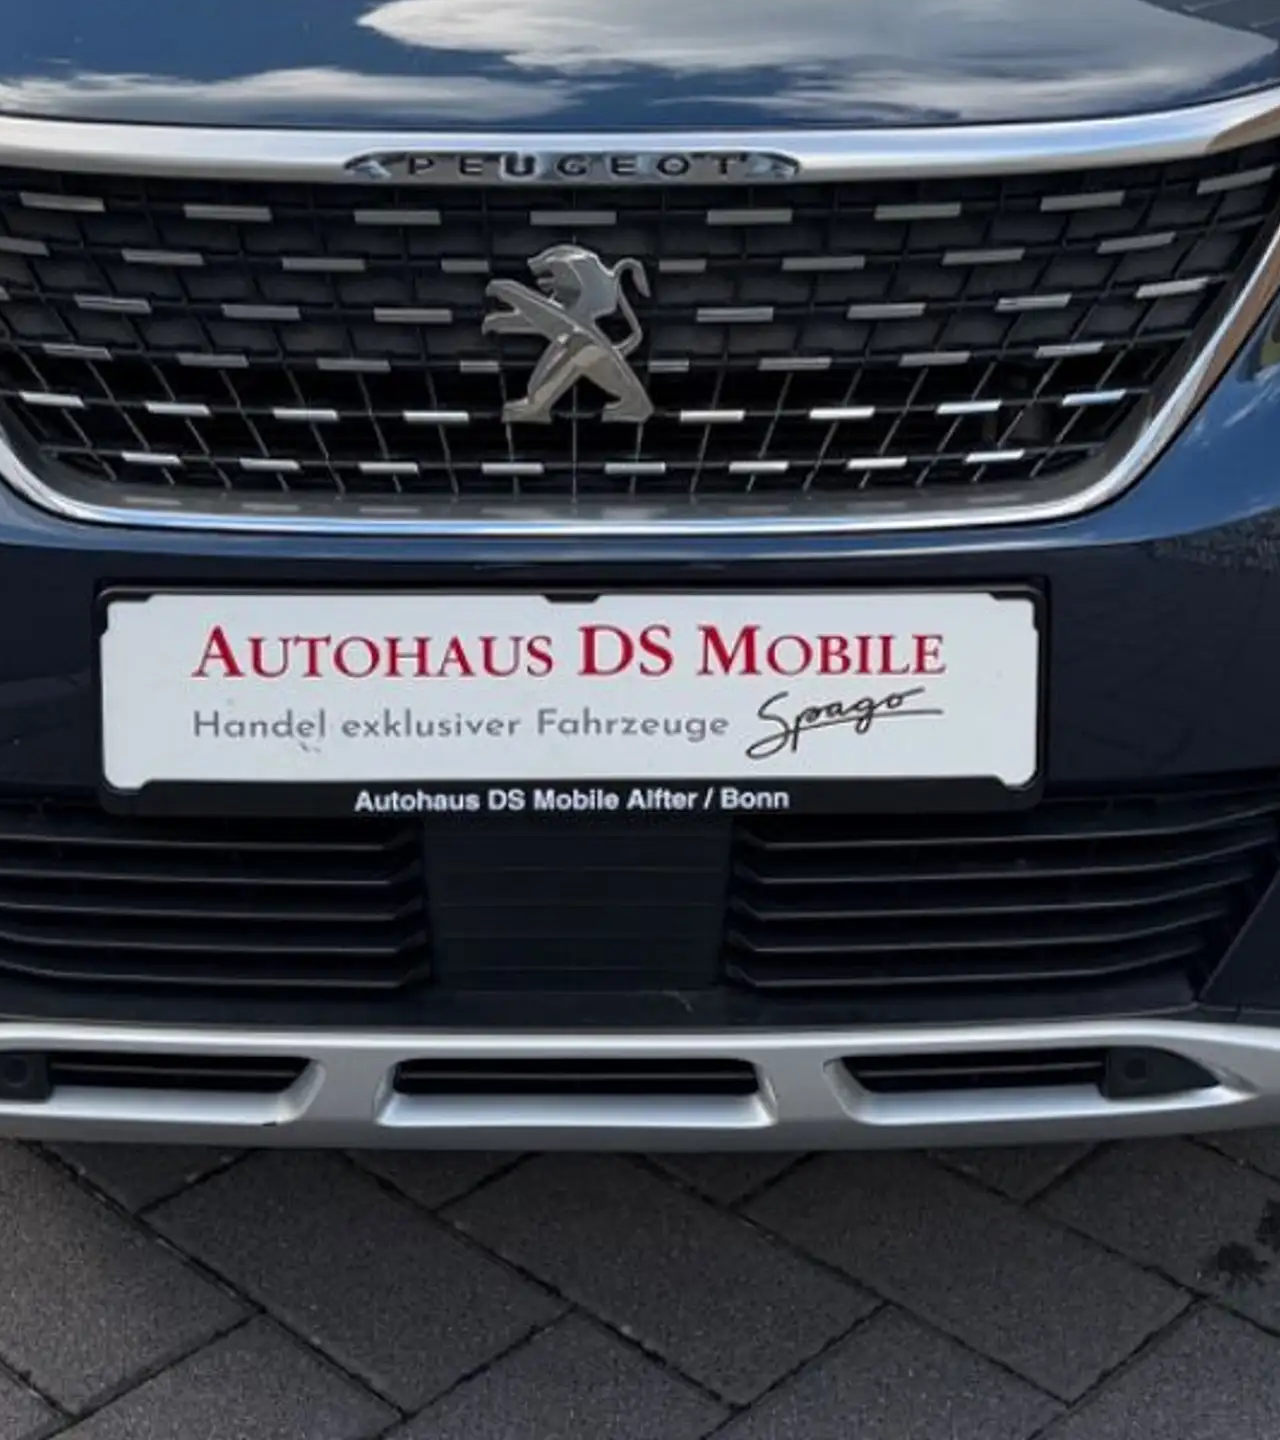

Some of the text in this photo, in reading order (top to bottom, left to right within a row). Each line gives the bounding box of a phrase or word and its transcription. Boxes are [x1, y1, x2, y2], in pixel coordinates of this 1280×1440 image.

[406, 152, 742, 178] PEUGEOT
[191, 624, 947, 679] AUTOHAUS DS MOBILE
[193, 707, 730, 745] Handel exklusiver Fahrzeuge
[745, 686, 944, 760] Spago
[354, 786, 790, 812] Autohaus DS Mobile Alfter / Bonn
